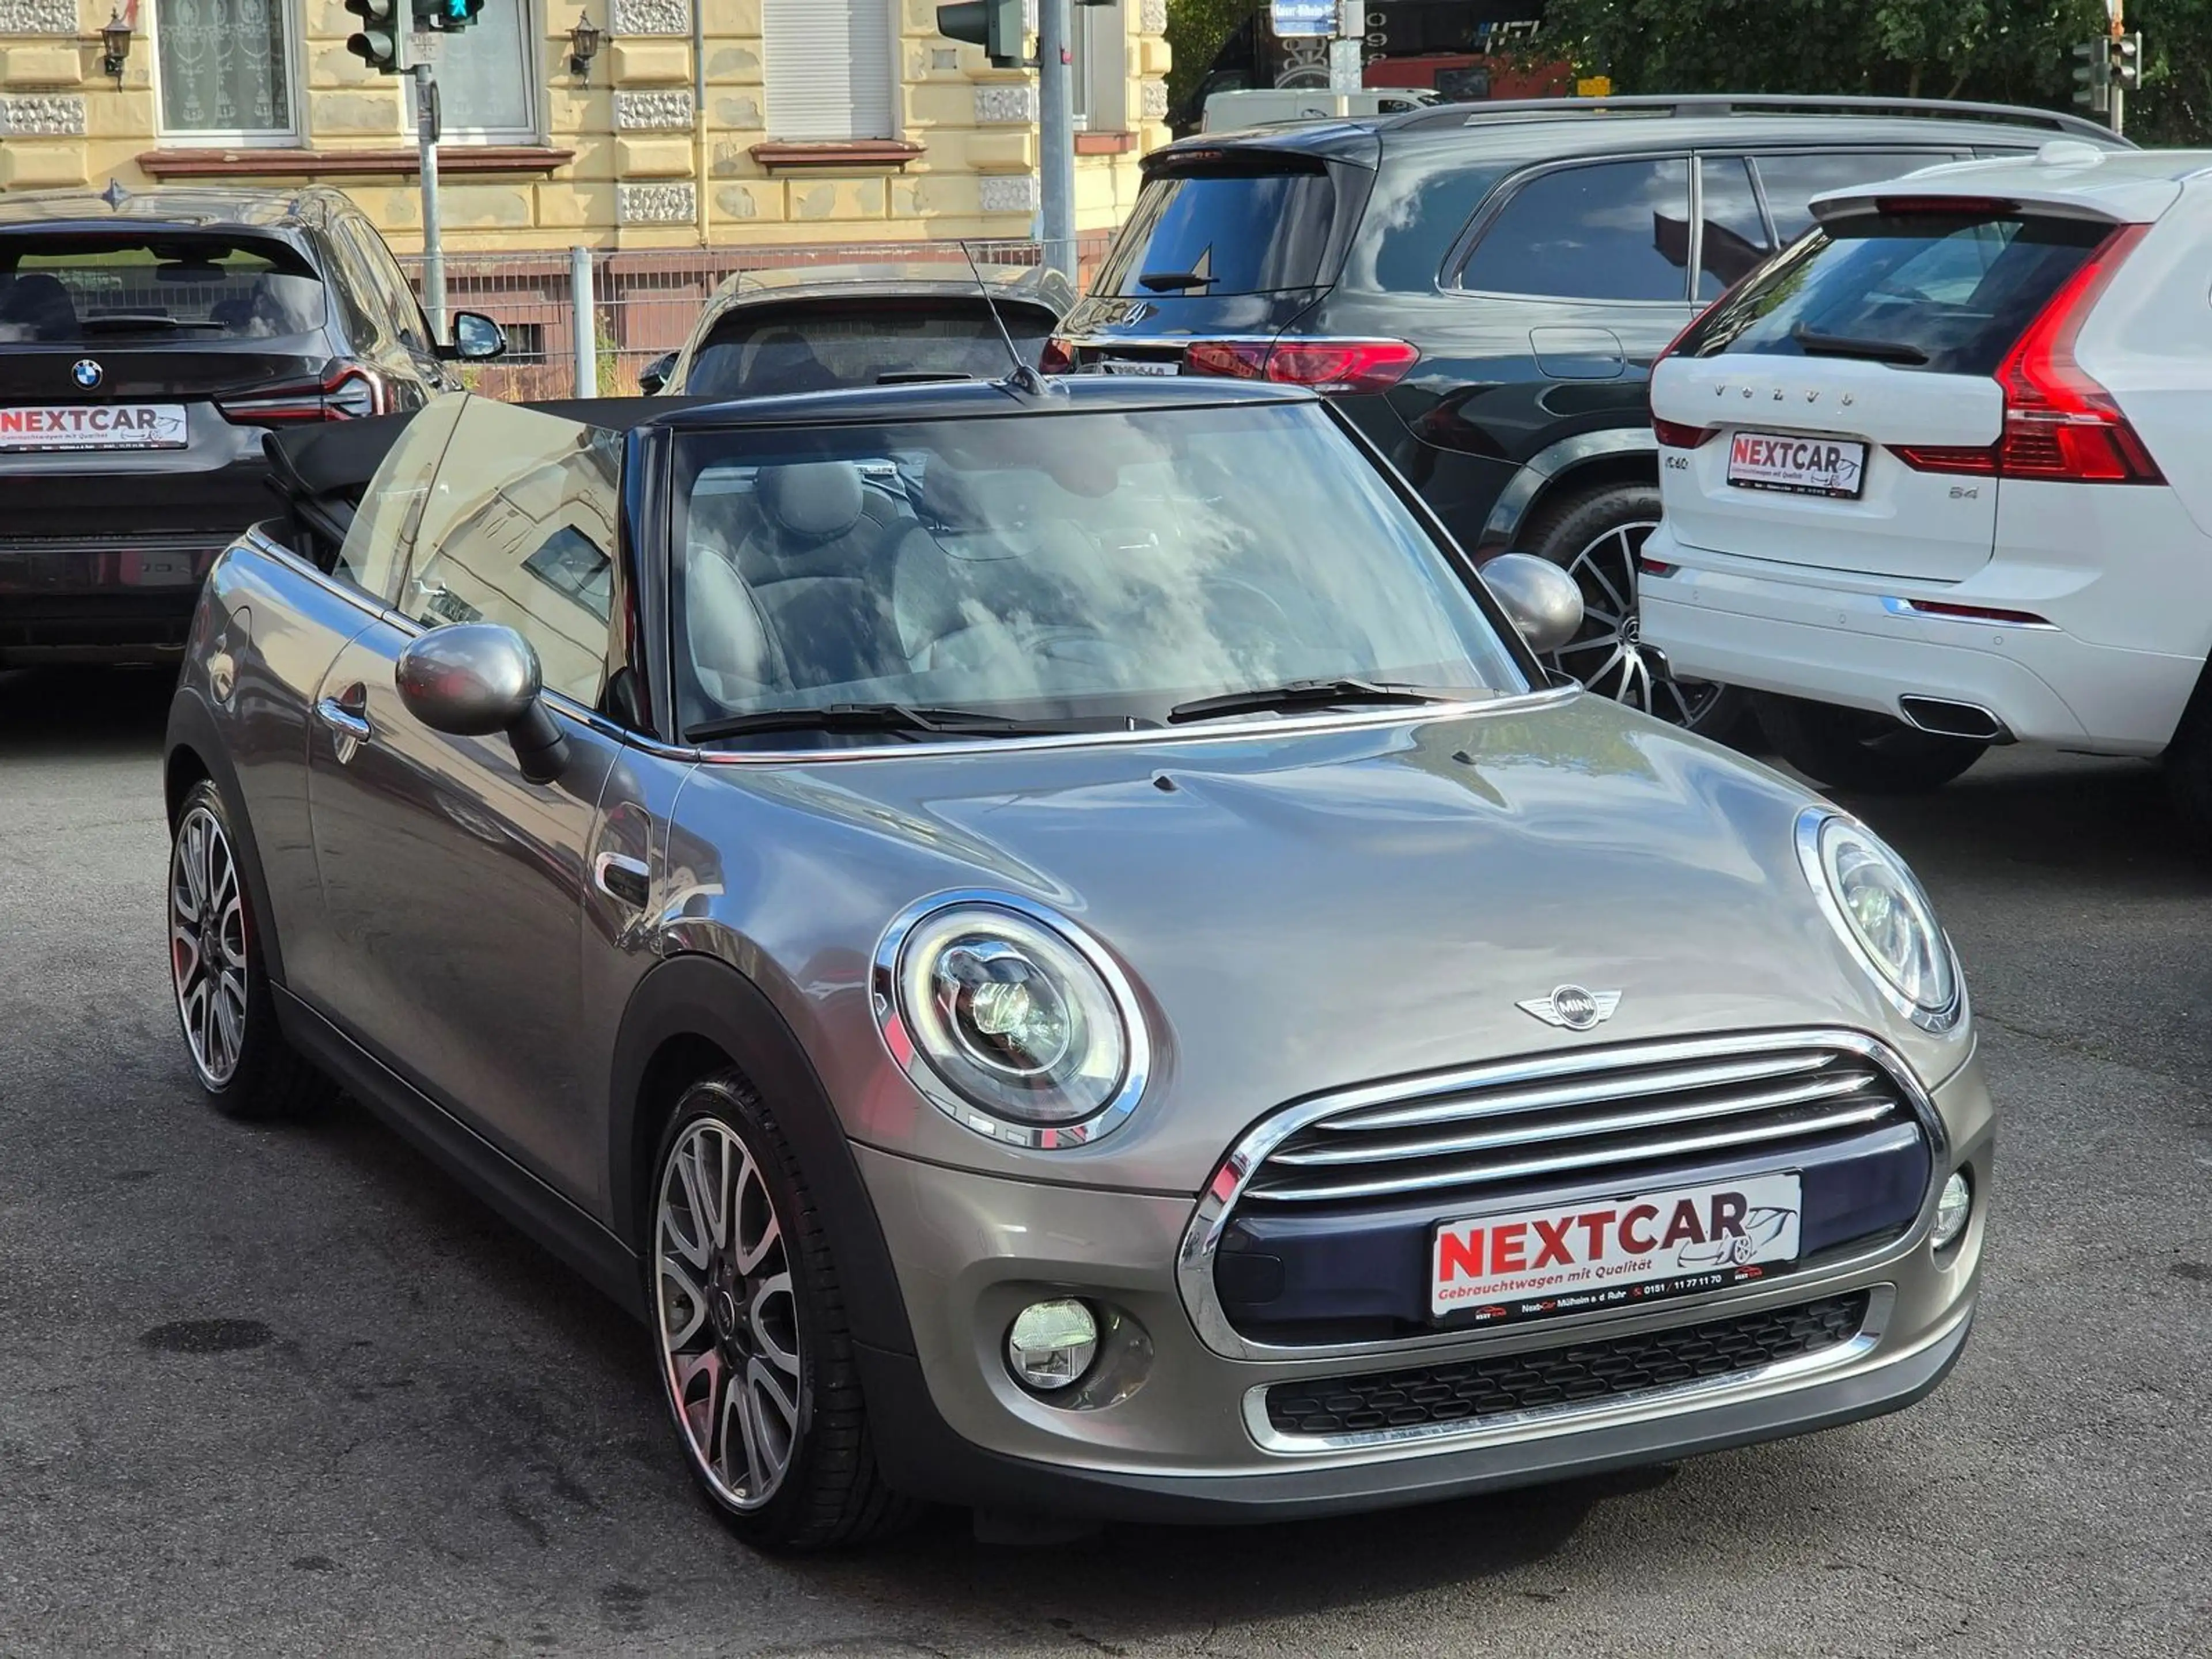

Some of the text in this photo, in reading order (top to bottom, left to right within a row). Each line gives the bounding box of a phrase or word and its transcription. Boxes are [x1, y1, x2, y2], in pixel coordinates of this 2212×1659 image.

[1, 409, 157, 432] NEXTCAR
[1733, 438, 1840, 474] NEXTCAR
[1559, 998, 1594, 1013] MINI
[1440, 1191, 1748, 1282] NEXTCAR
[1438, 1259, 1652, 1300] Gebrauchtwagen mit Qualität
[1608, 1290, 1627, 1300] Ruhr
[1643, 1283, 1665, 1294] 0151
[1674, 1281, 1684, 1289] 11
[1687, 1278, 1697, 1287] 77
[1699, 1276, 1709, 1285] 11
[1710, 1274, 1722, 1283] 70
